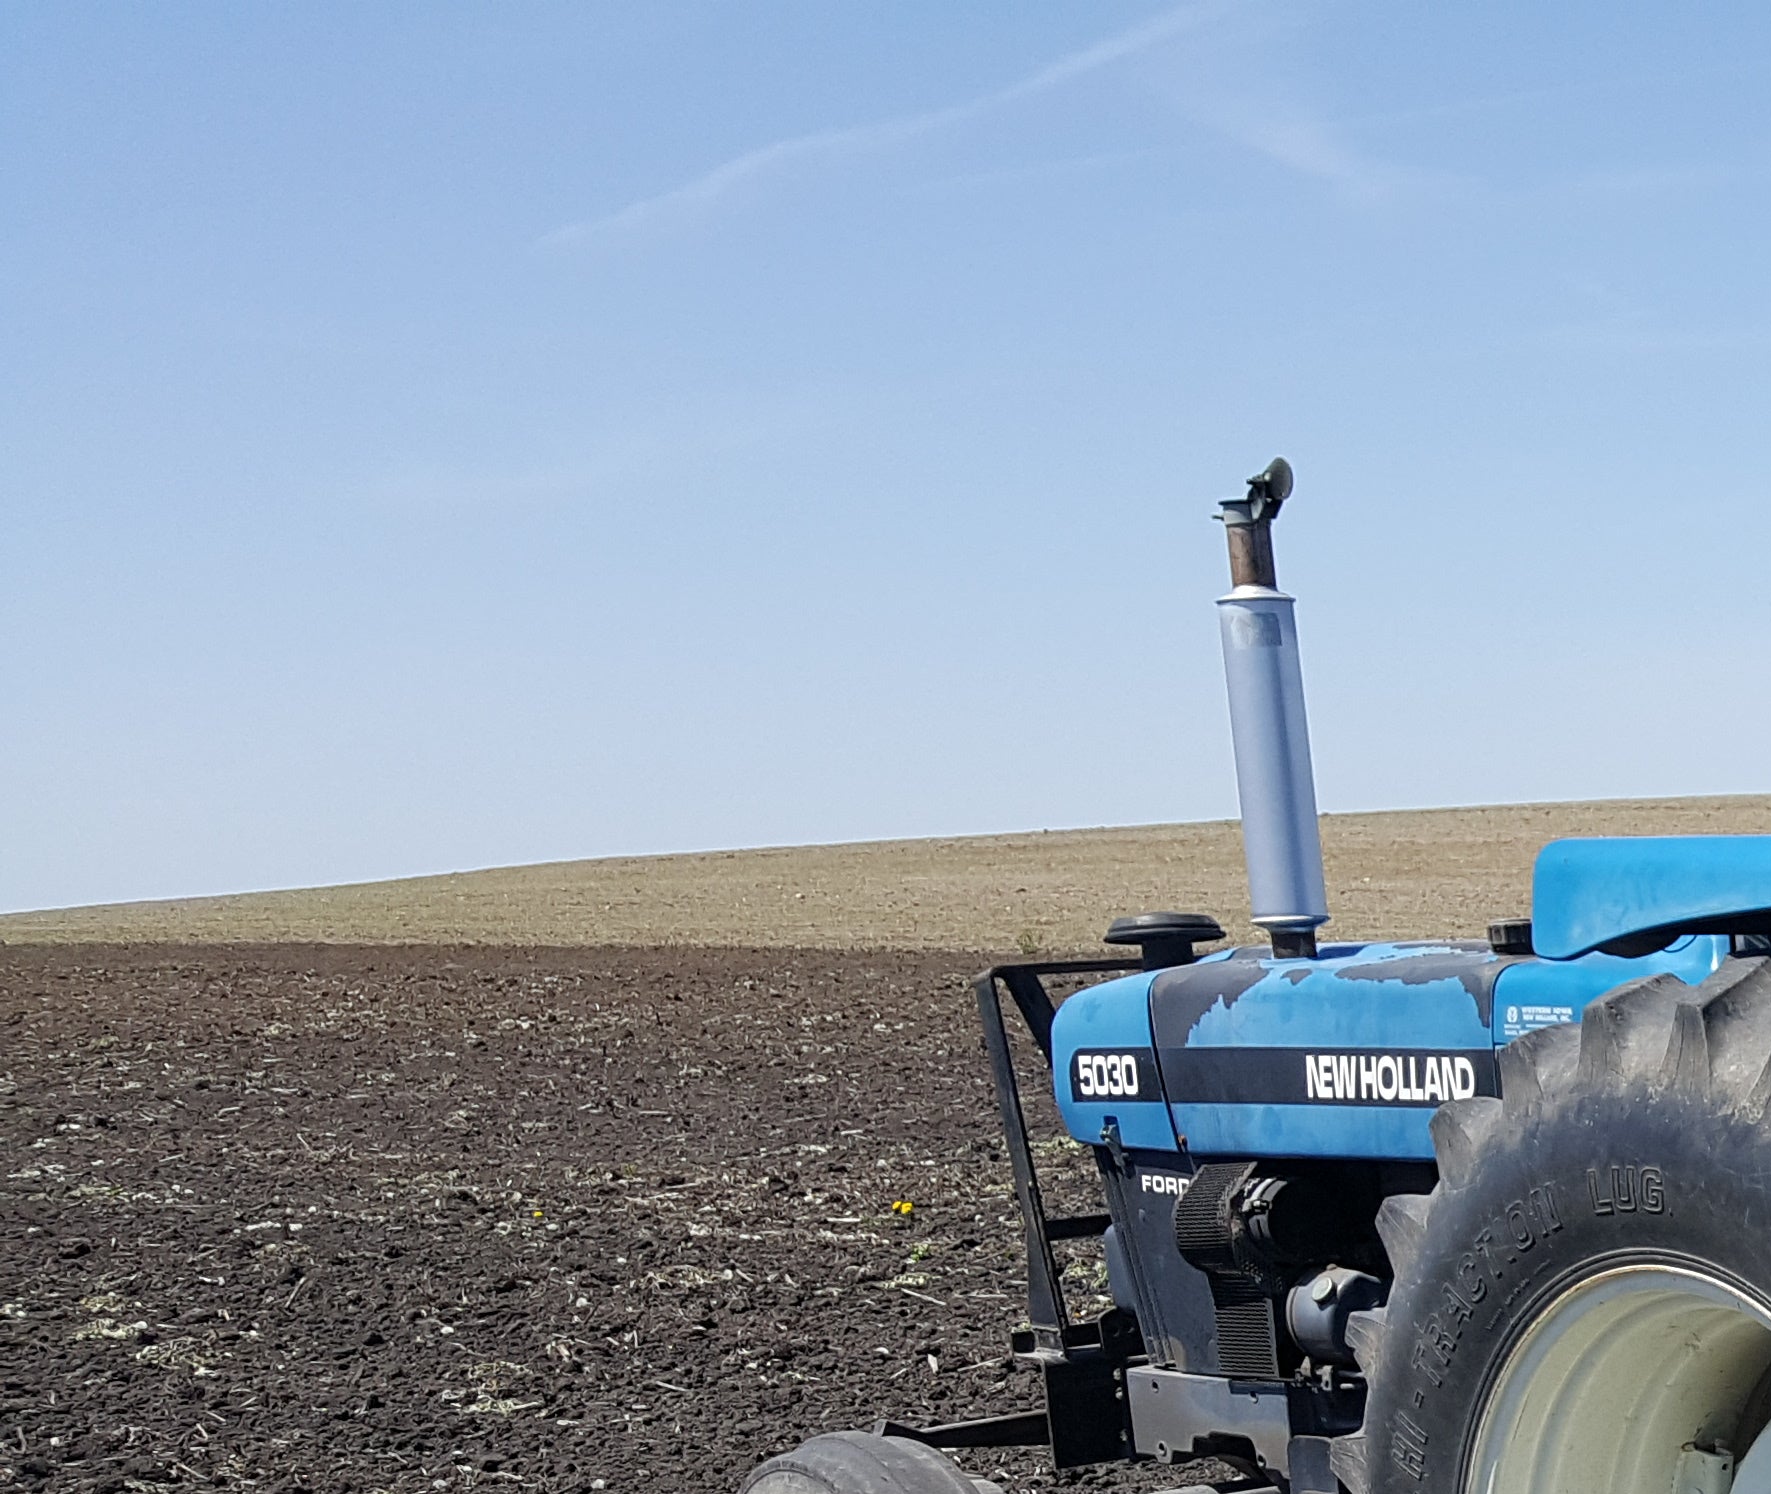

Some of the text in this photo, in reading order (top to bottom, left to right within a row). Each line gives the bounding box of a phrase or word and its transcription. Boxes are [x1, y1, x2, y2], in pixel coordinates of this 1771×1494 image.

[1077, 1054, 1138, 1096] 5030
[1305, 1054, 1475, 1101] NEW HOLLAND
[1141, 1174, 1190, 1195] FORD
[1587, 1165, 1665, 1215] LUG
